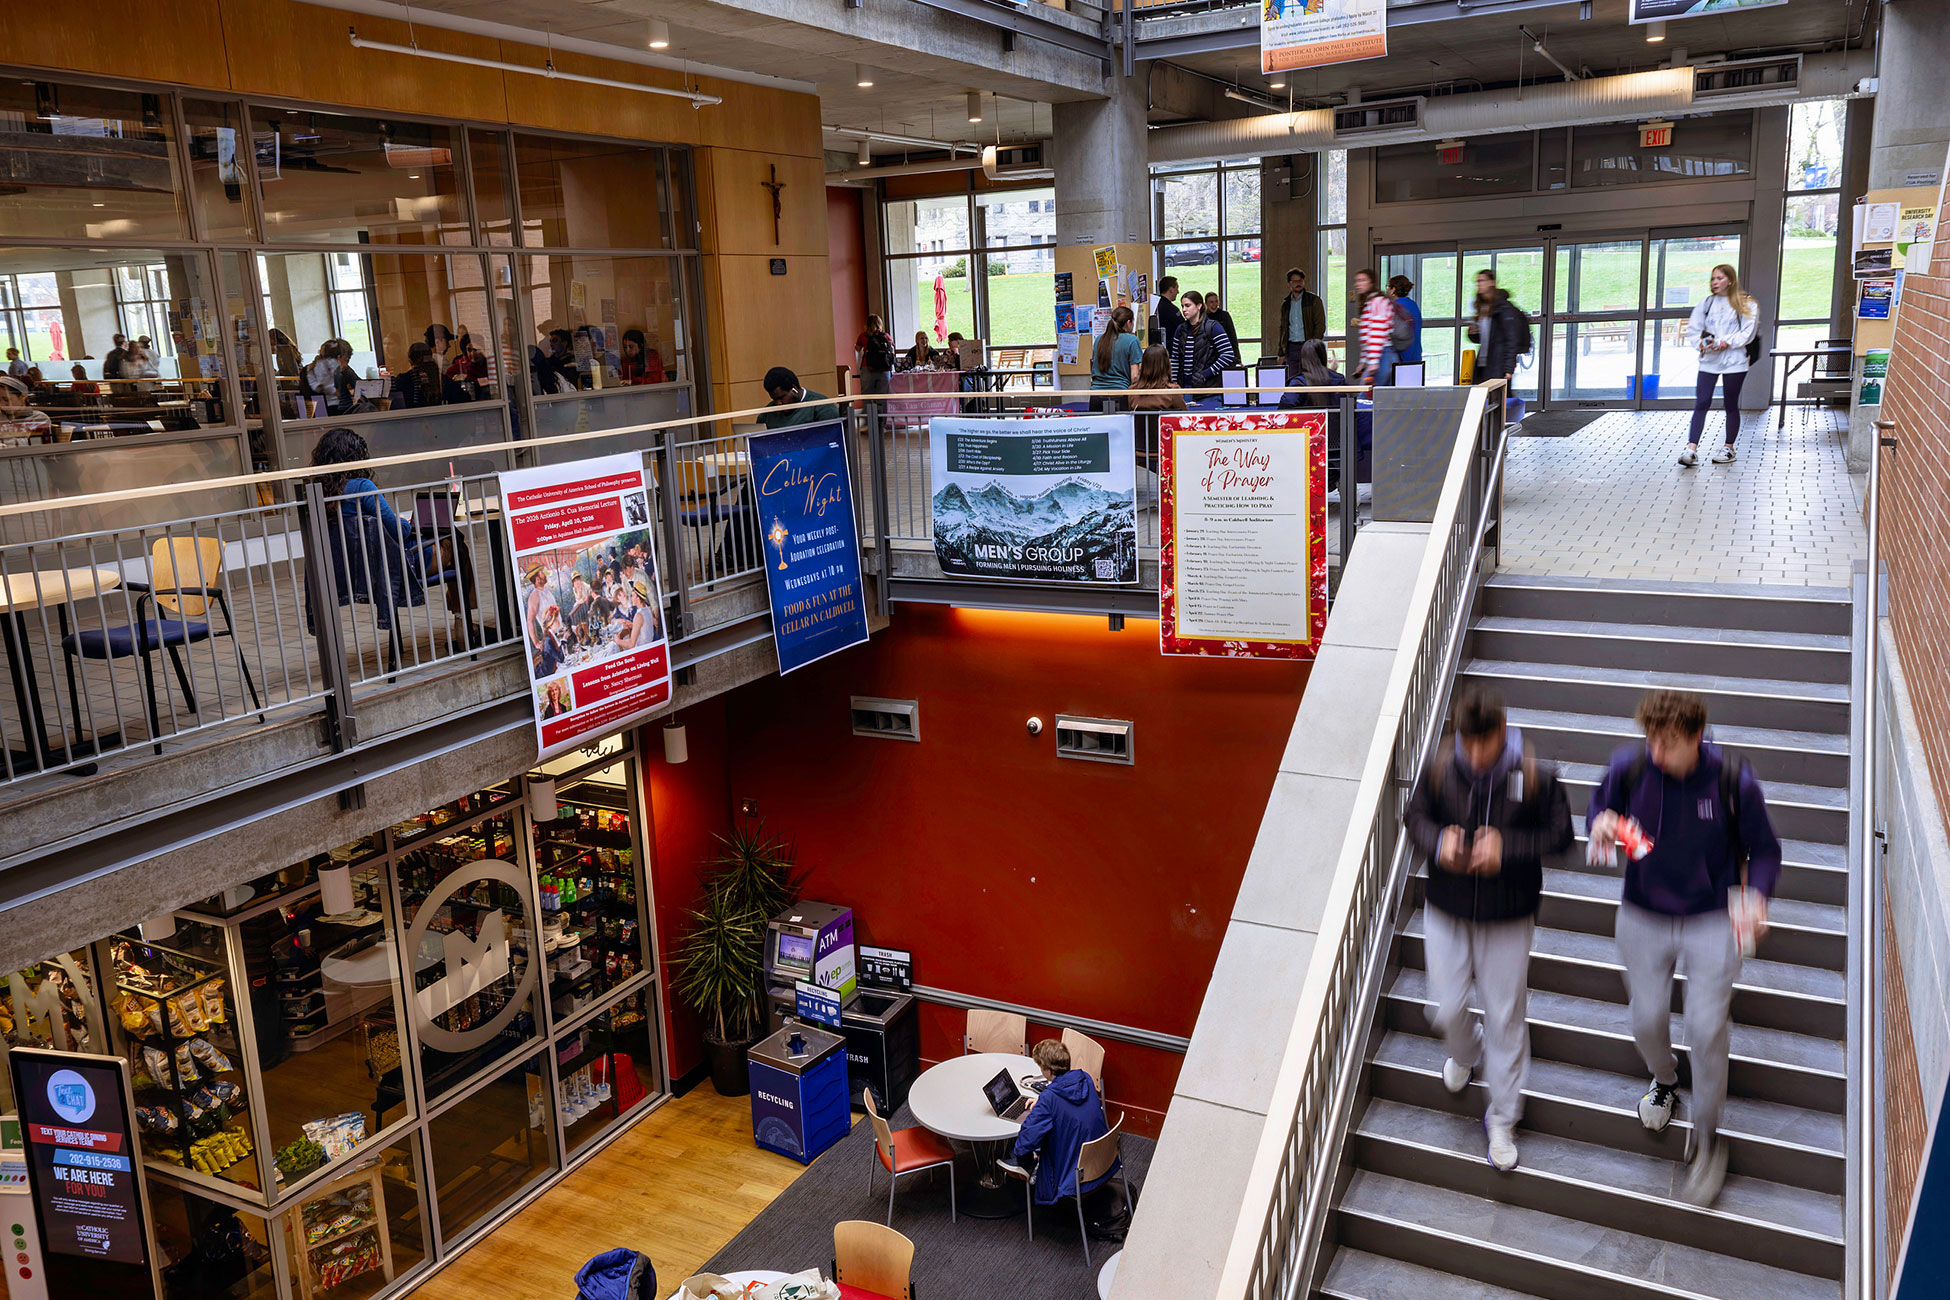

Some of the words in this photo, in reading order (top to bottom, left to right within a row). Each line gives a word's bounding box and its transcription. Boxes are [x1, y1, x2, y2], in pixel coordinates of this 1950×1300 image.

[1279, 48, 1312, 57] PONTIFICAL
[1313, 45, 1329, 53] JOHN
[1331, 42, 1346, 50] PAUL
[1352, 38, 1382, 47] INSTITUTE
[1646, 129, 1667, 146] EXIT
[1443, 148, 1458, 164] EXIT
[1204, 448, 1230, 469] The
[1234, 447, 1270, 471] Way
[543, 490, 562, 498] University
[601, 479, 620, 487] Philosophy
[1054, 476, 1072, 488] Starting
[1077, 476, 1092, 486] Friday
[1201, 470, 1214, 492] of
[1218, 469, 1274, 492] Prayer
[803, 473, 842, 516] Night
[540, 512, 560, 520] Antonio
[578, 503, 599, 512] Memorial
[600, 500, 617, 508] Lecture
[544, 522, 560, 530] Friday,
[561, 518, 573, 527] April
[808, 528, 825, 540] WEEKLY
[826, 525, 839, 536] POST-
[558, 530, 573, 538] Aquinas
[790, 548, 816, 562] ADORATION
[816, 540, 845, 555] CELEBRATION
[974, 544, 1022, 559] MEN'S
[1026, 547, 1084, 562] GROUP
[976, 561, 1002, 569] FORMING
[1021, 564, 1052, 572] PURSUING
[784, 571, 820, 590] WEDNESDAYS
[821, 569, 827, 578] AT
[828, 565, 834, 576] 10
[784, 601, 804, 617] FOOD
[805, 599, 811, 609] &
[812, 594, 828, 607] FUN
[828, 590, 837, 600] AT
[838, 584, 852, 597] THE
[781, 617, 810, 636] CELLAR
[811, 613, 818, 625] IN
[820, 600, 856, 622] CALDWELL
[819, 929, 838, 952] ATM
[807, 986, 827, 998] RECYCLING
[846, 1053, 868, 1063] TRASH
[66, 1094, 83, 1106] CHAT
[758, 1090, 794, 1110] RECYCLING
[40, 1127, 53, 1135] TEXT
[69, 1153, 122, 1168] 202-915-2536
[53, 1166, 69, 1180] WE
[70, 1169, 89, 1184] ARE
[89, 1171, 114, 1186] HERE
[66, 1182, 84, 1195] FOR
[84, 1183, 106, 1198] YOU!
[76, 1230, 109, 1240] UNIVERSITY
[81, 1225, 109, 1234] CATHOLIC
